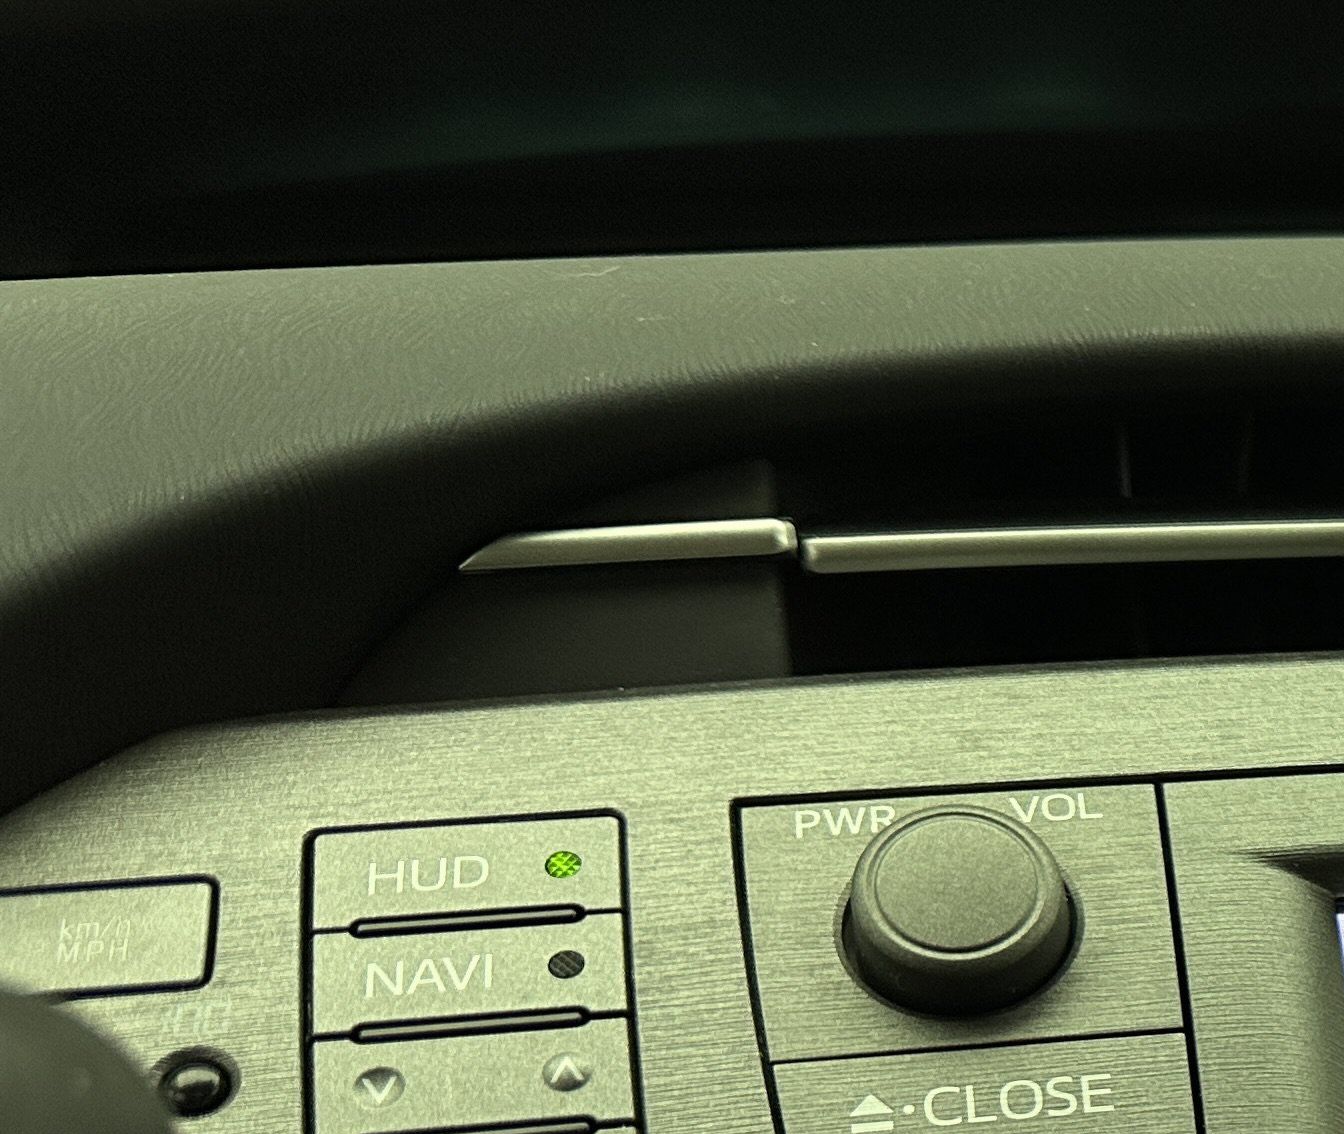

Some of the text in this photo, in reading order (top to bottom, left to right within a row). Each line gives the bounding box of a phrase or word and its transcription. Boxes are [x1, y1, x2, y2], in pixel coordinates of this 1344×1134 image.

[794, 805, 897, 839] PWR
[1009, 793, 1104, 824] VOL
[365, 854, 490, 896] HUD
[57, 938, 129, 965] MPH
[364, 952, 495, 998] NAVI
